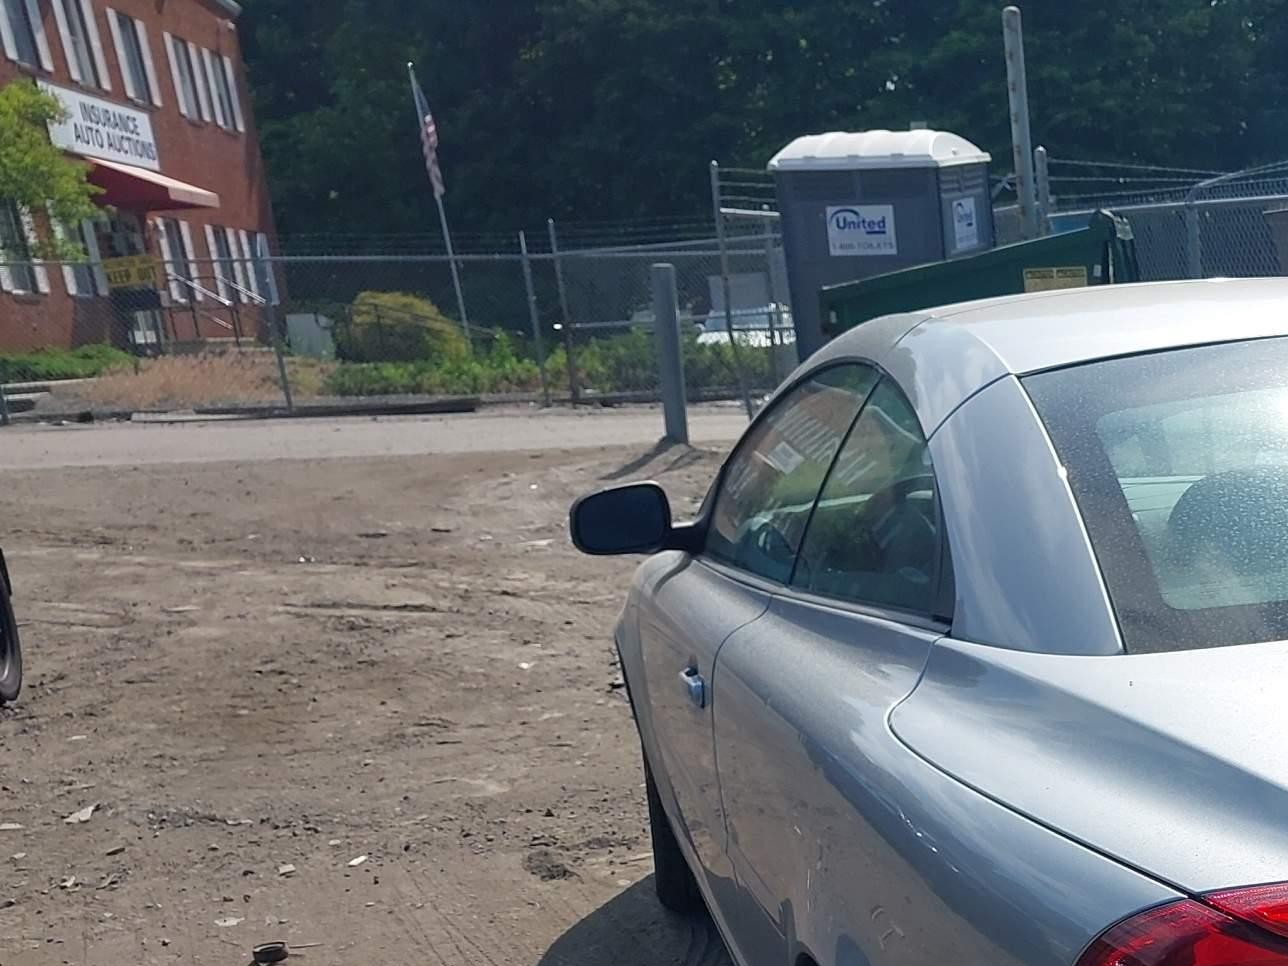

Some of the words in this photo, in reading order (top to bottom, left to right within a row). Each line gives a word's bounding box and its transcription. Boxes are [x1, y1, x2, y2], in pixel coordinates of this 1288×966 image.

[79, 101, 140, 136] INSURANCE
[74, 122, 104, 148] AUTO
[106, 132, 157, 161] AUCTIONS
[836, 215, 886, 231] United
